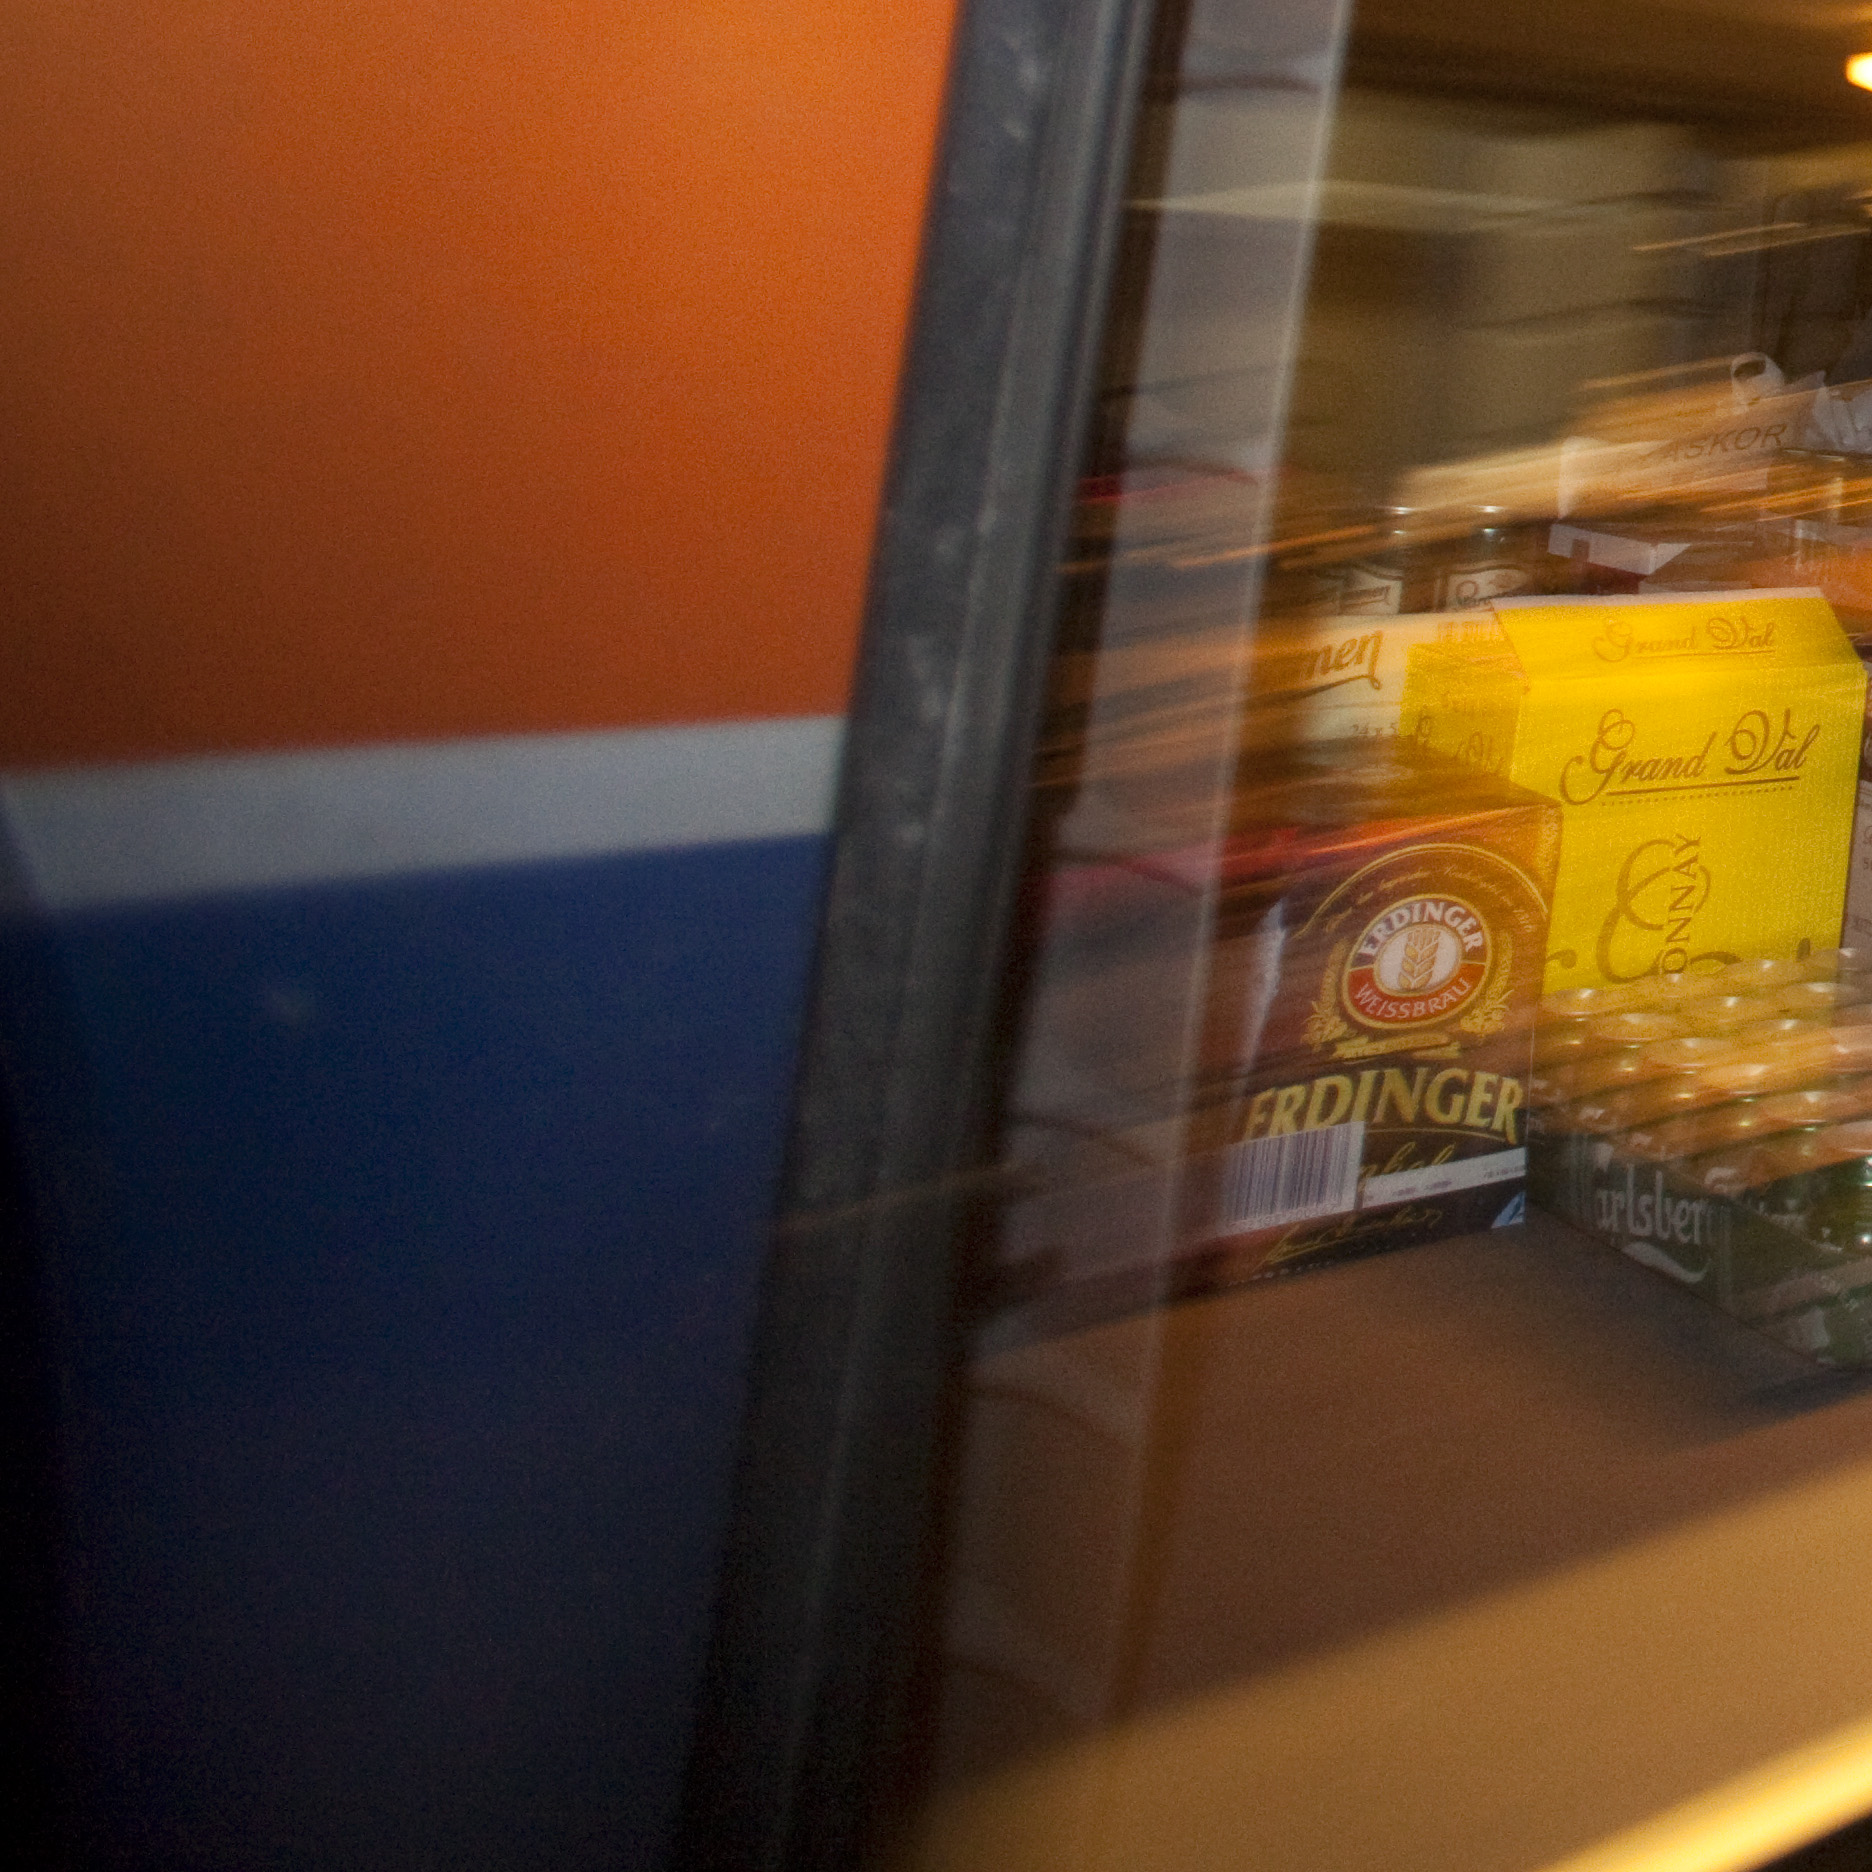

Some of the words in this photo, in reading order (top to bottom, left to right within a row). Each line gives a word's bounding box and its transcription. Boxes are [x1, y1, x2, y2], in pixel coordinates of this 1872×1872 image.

[1592, 616, 1697, 663] Grand
[1706, 617, 1776, 650] Val
[1559, 708, 1718, 806] Grand
[1724, 708, 1821, 776] Val
[1359, 901, 1484, 957] ERDINGER
[1243, 1066, 1524, 1146] ERDINGER
